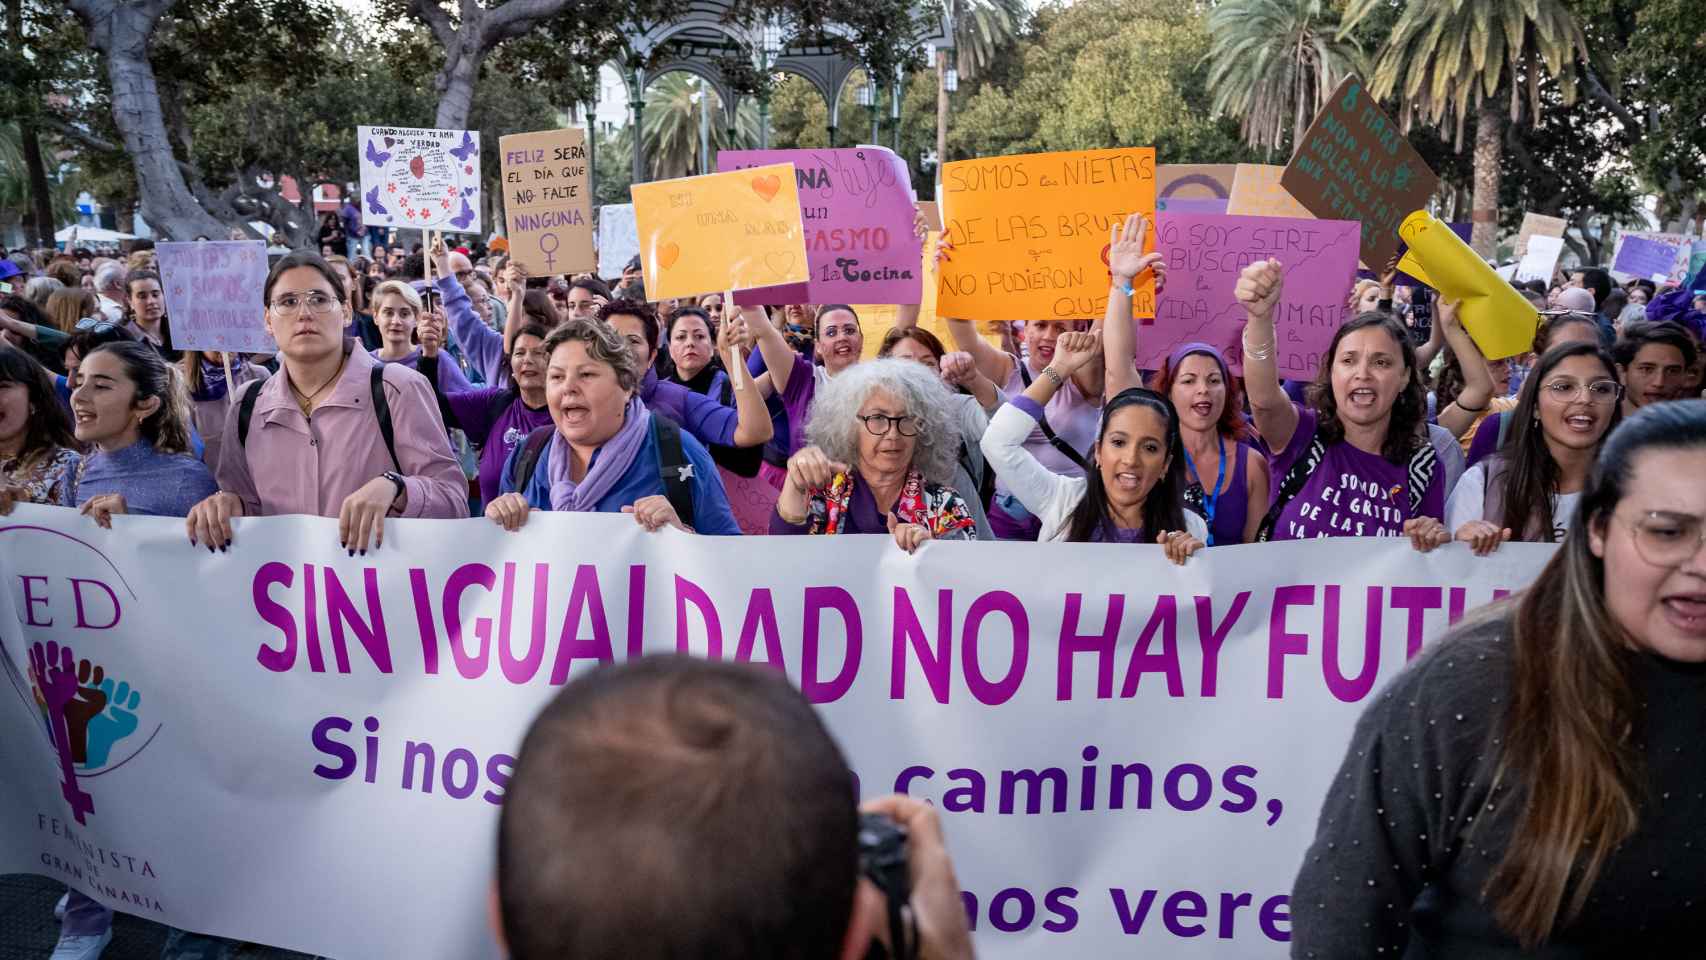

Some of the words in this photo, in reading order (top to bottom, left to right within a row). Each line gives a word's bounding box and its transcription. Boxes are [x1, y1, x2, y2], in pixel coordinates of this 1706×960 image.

[506, 149, 545, 166] FELIZ
[553, 142, 587, 162] SERÁ
[507, 171, 523, 184] EL
[534, 167, 554, 180] DÍA
[561, 166, 586, 179] QUE
[949, 161, 1031, 193] SOMOS
[543, 184, 579, 201] FALTE
[514, 208, 585, 233] NINGUNA
[949, 217, 985, 247] DE
[995, 214, 1049, 243] LAS
[805, 226, 890, 252] ASMO
[1189, 223, 1243, 248] SOY
[1251, 226, 1322, 253] SIRI
[939, 273, 977, 297] NO
[1299, 501, 1322, 522] DE
[1329, 511, 1366, 537] LAS
[1320, 486, 1343, 507] EL
[1349, 497, 1402, 524] GRITO
[16, 574, 121, 630] ED
[252, 561, 394, 675] SIN
[889, 584, 1031, 707] NO
[1056, 590, 1252, 702] HAY
[1266, 584, 1511, 703] FUT
[311, 714, 381, 784] Si
[39, 852, 83, 881] GRAN
[1108, 887, 1294, 943] vere
